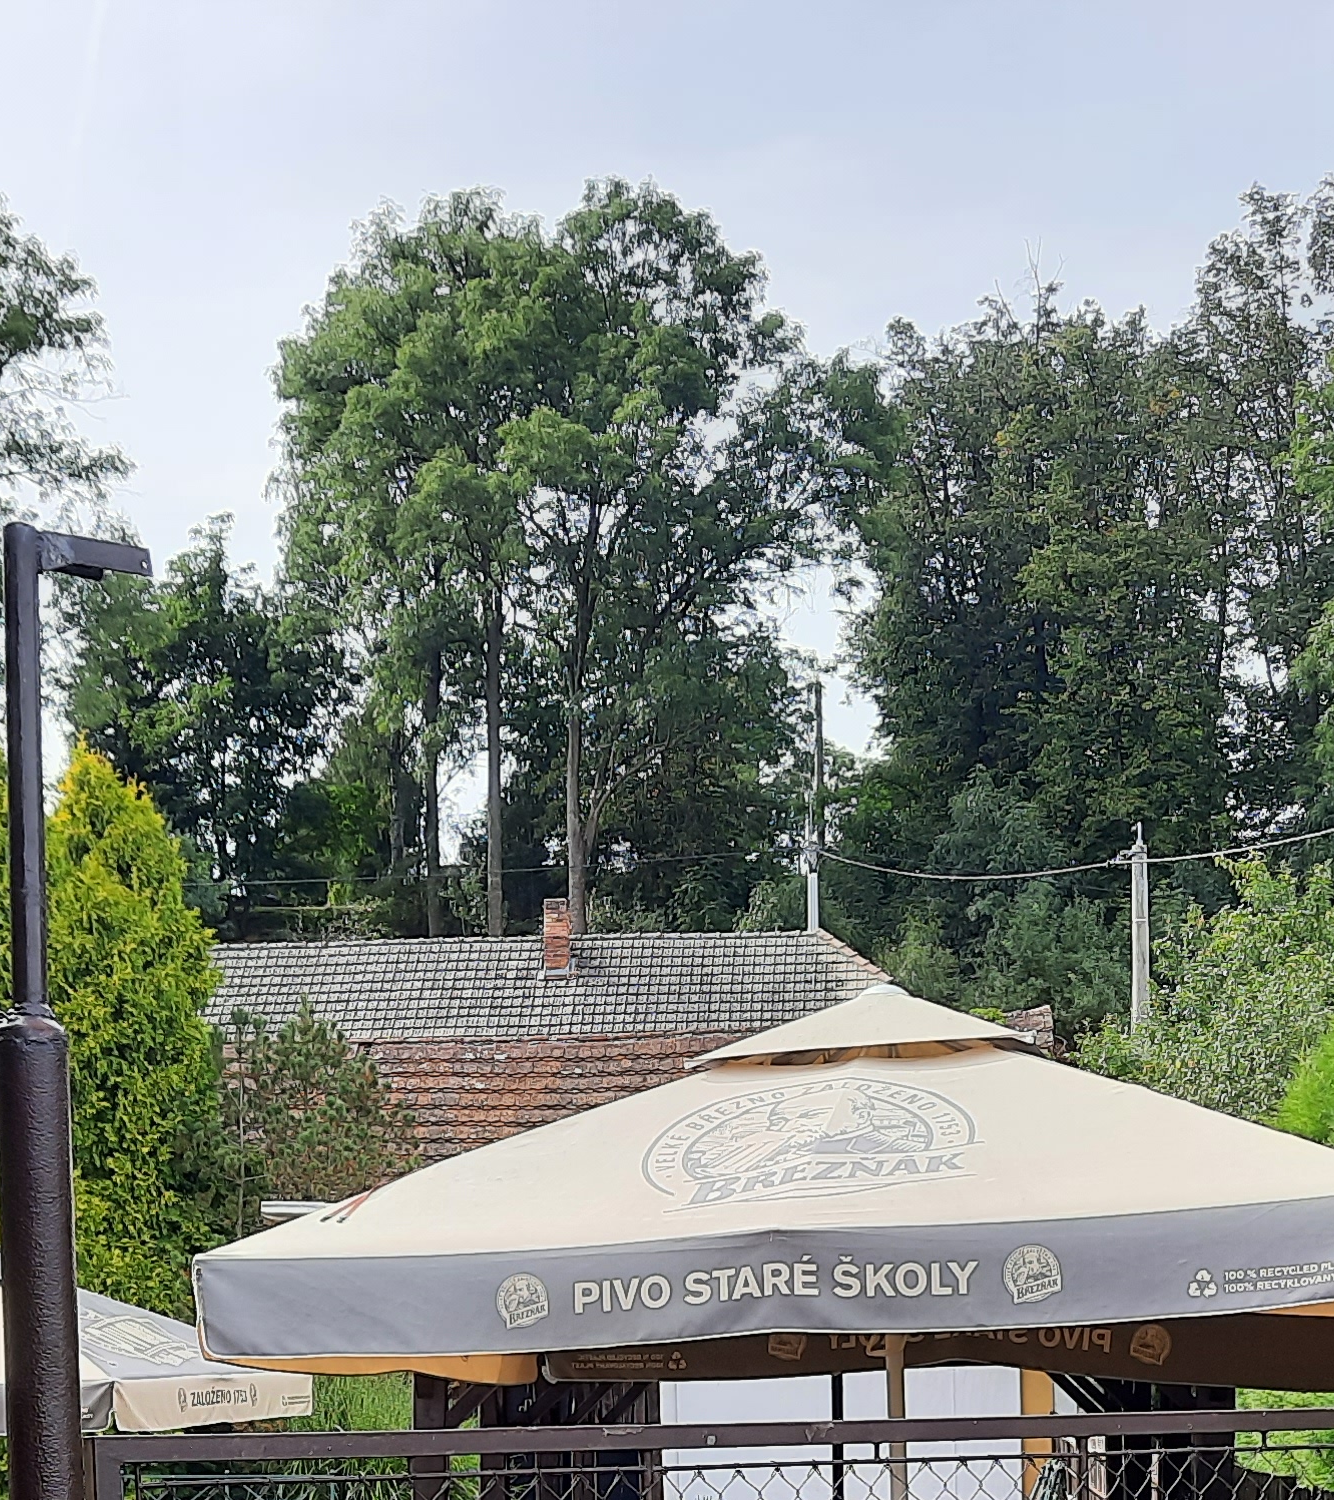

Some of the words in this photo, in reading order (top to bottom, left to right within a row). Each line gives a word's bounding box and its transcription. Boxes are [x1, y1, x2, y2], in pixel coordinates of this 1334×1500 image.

[802, 1081, 938, 1112] ZALOŽENO
[1223, 1270, 1244, 1281] 100
[1259, 1264, 1318, 1278] RECYCLED
[573, 1274, 672, 1314] PIVO
[683, 1254, 820, 1305] STARÉ
[832, 1254, 979, 1298] ŠKOLY
[1223, 1281, 1254, 1293] 100%
[190, 1387, 231, 1407] ZALOŽENO
